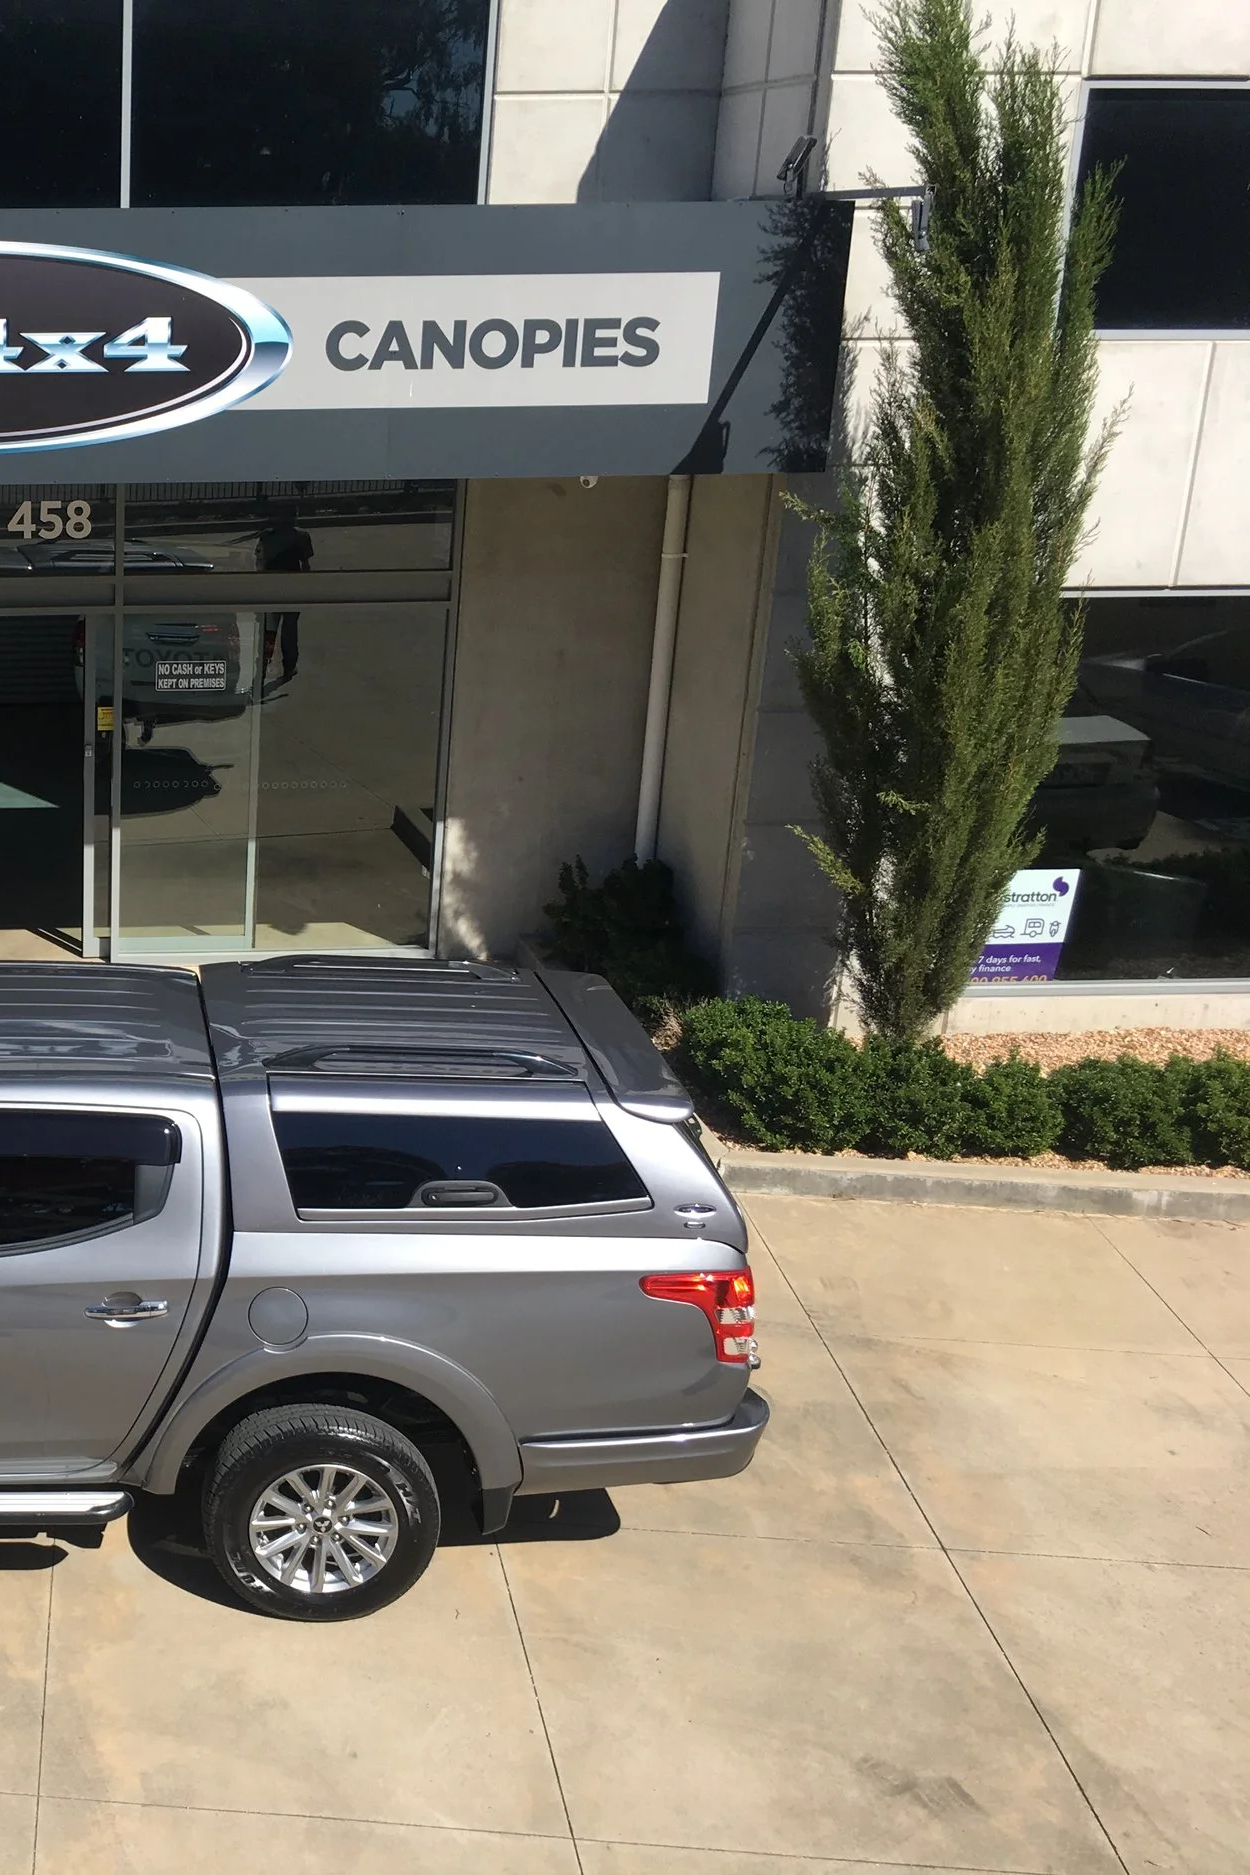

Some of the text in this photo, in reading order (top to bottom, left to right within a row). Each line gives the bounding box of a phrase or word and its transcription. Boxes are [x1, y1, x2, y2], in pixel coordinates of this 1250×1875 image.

[325, 316, 661, 371] CANOPIES
[7, 500, 92, 540] 458
[158, 663, 225, 675] NO CASH or KEYS
[158, 678, 225, 689] KEPT ON PREMISES
[1003, 891, 1057, 903] stratton
[978, 955, 985, 964] 7
[986, 956, 1007, 965] days
[1009, 954, 1022, 963] for
[978, 964, 1011, 973] finance
